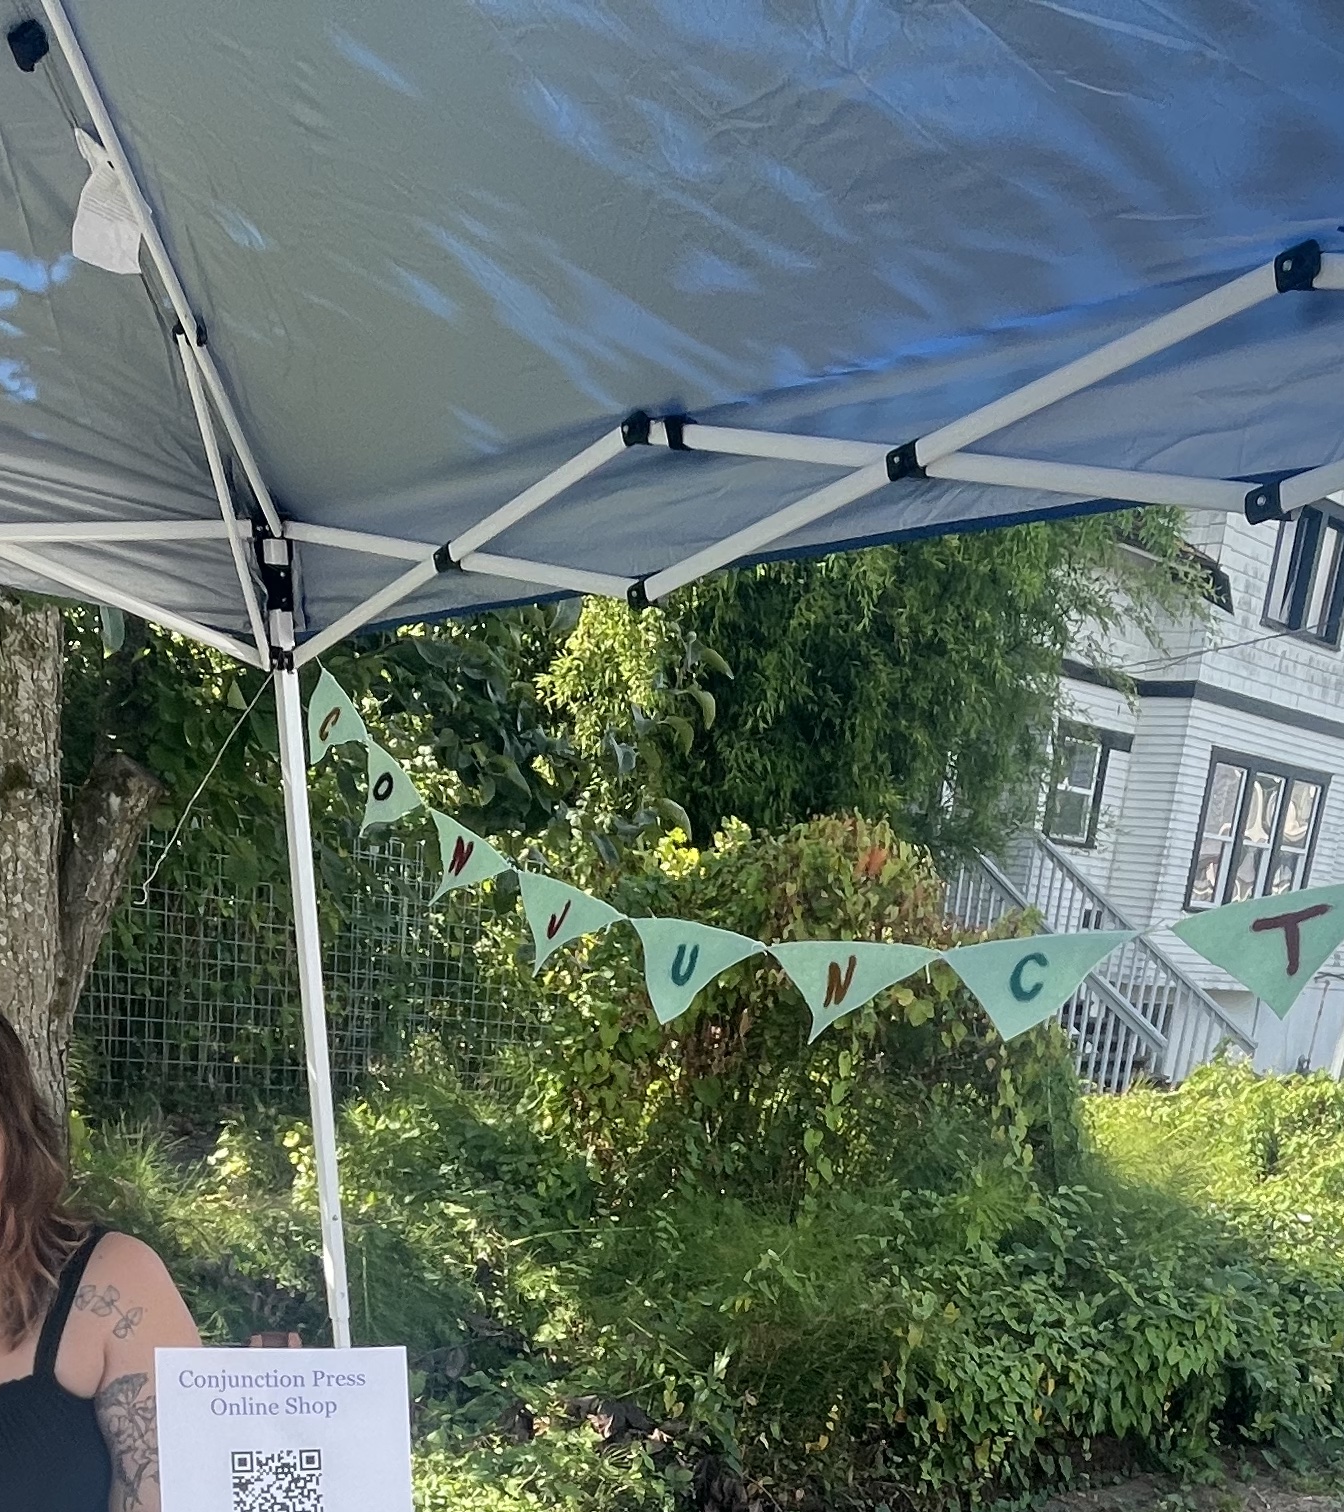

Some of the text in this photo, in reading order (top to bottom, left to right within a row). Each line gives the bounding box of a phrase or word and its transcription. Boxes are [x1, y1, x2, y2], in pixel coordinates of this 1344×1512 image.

[179, 1369, 367, 1393] Conjunction Press
[210, 1396, 338, 1418] Online Shop
